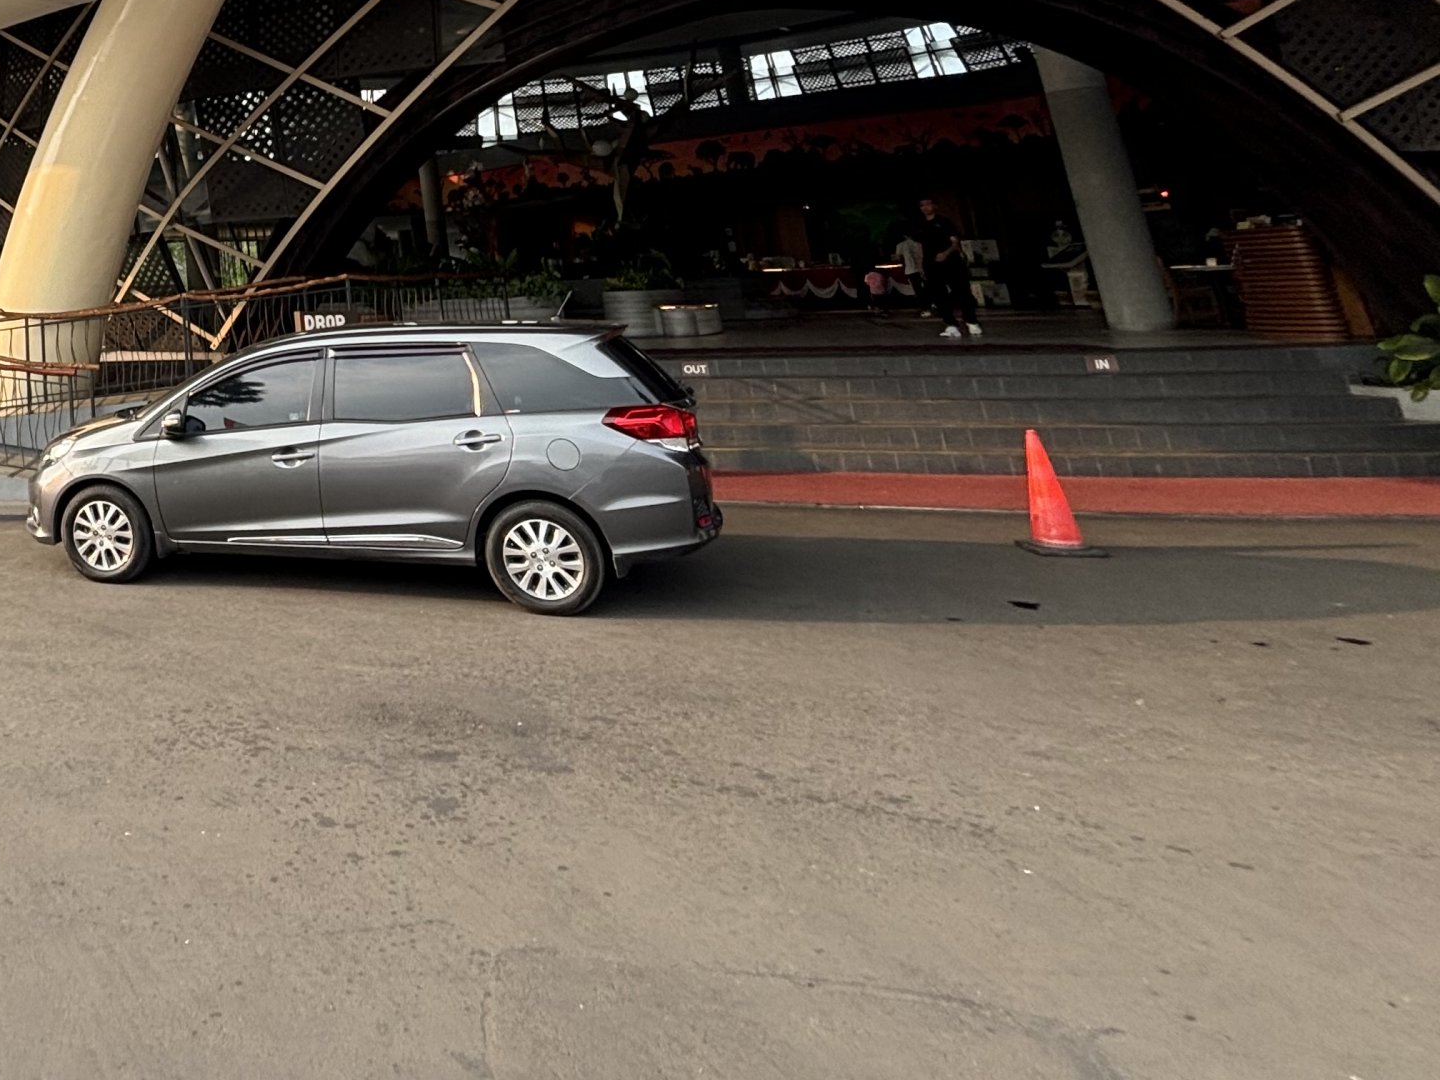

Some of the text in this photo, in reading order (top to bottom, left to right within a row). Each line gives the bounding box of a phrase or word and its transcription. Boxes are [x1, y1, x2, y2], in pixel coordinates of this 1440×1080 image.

[303, 314, 346, 331] DROP
[683, 364, 707, 374] OUT
[1094, 359, 1110, 370] IN
